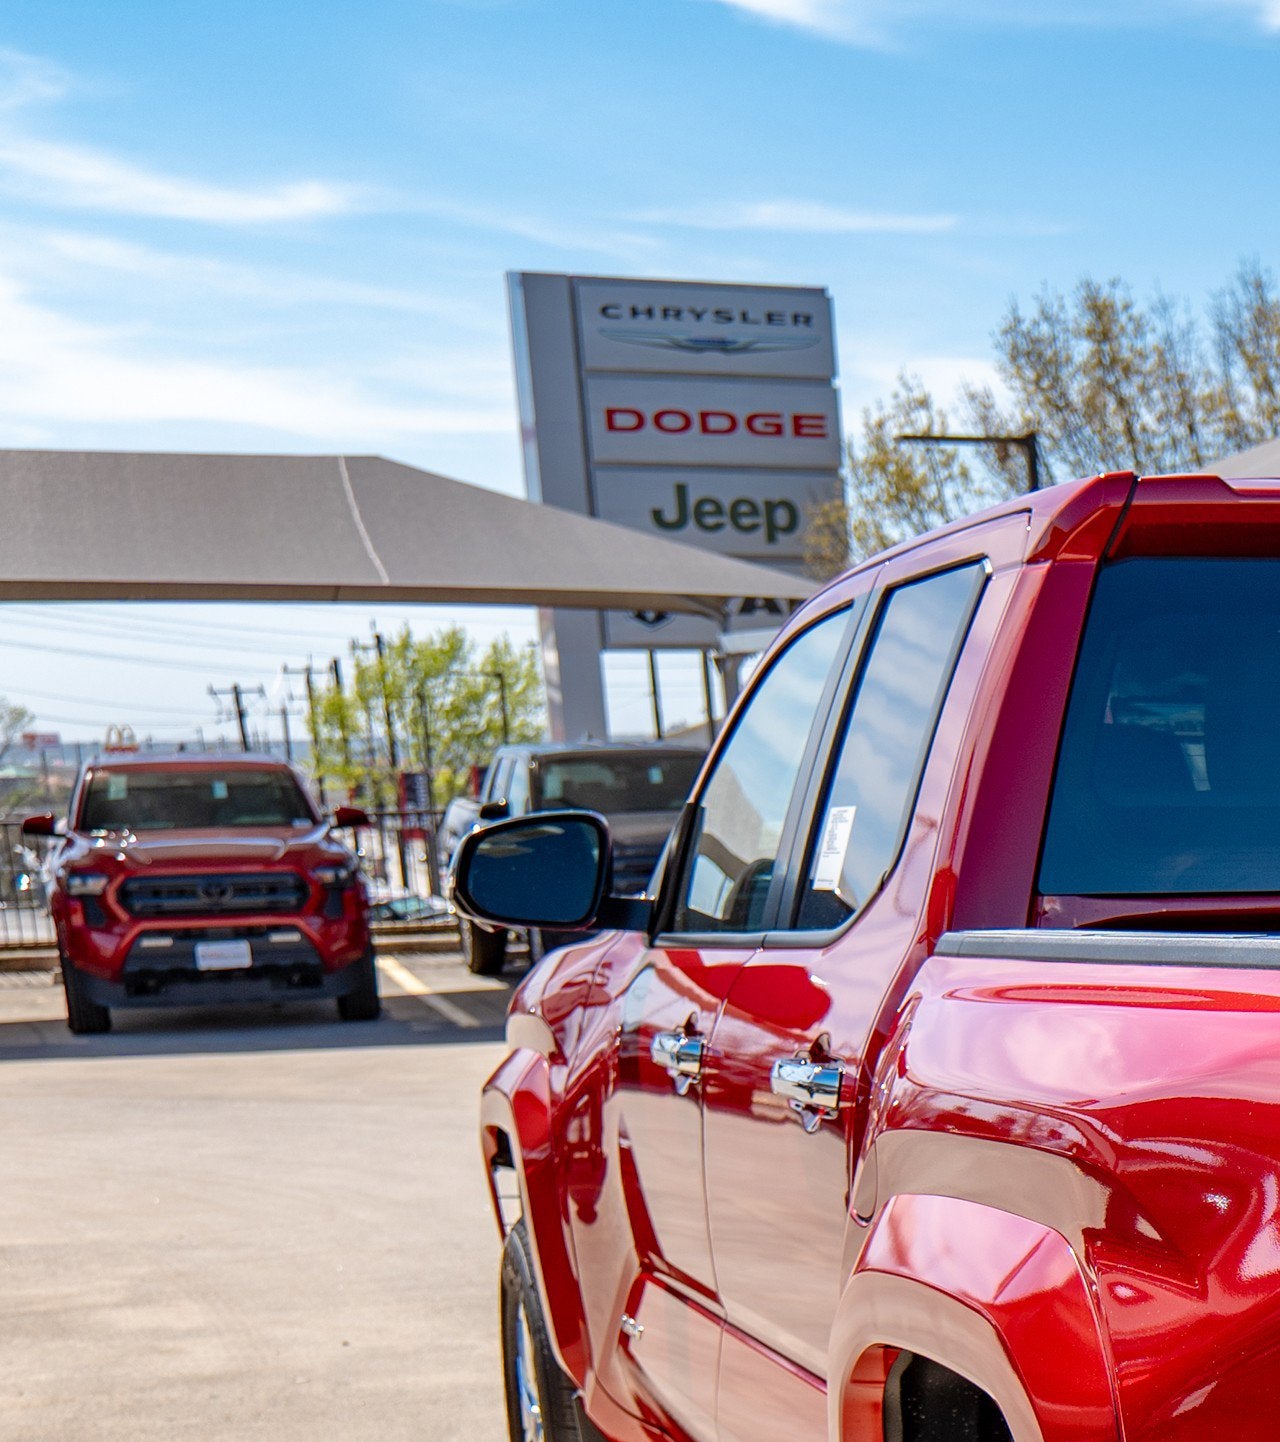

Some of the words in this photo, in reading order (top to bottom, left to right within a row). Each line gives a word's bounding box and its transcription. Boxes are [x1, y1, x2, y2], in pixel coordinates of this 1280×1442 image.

[600, 303, 815, 328] CHRYSLER
[604, 407, 828, 438] DODGE
[651, 482, 798, 543] Jeep
